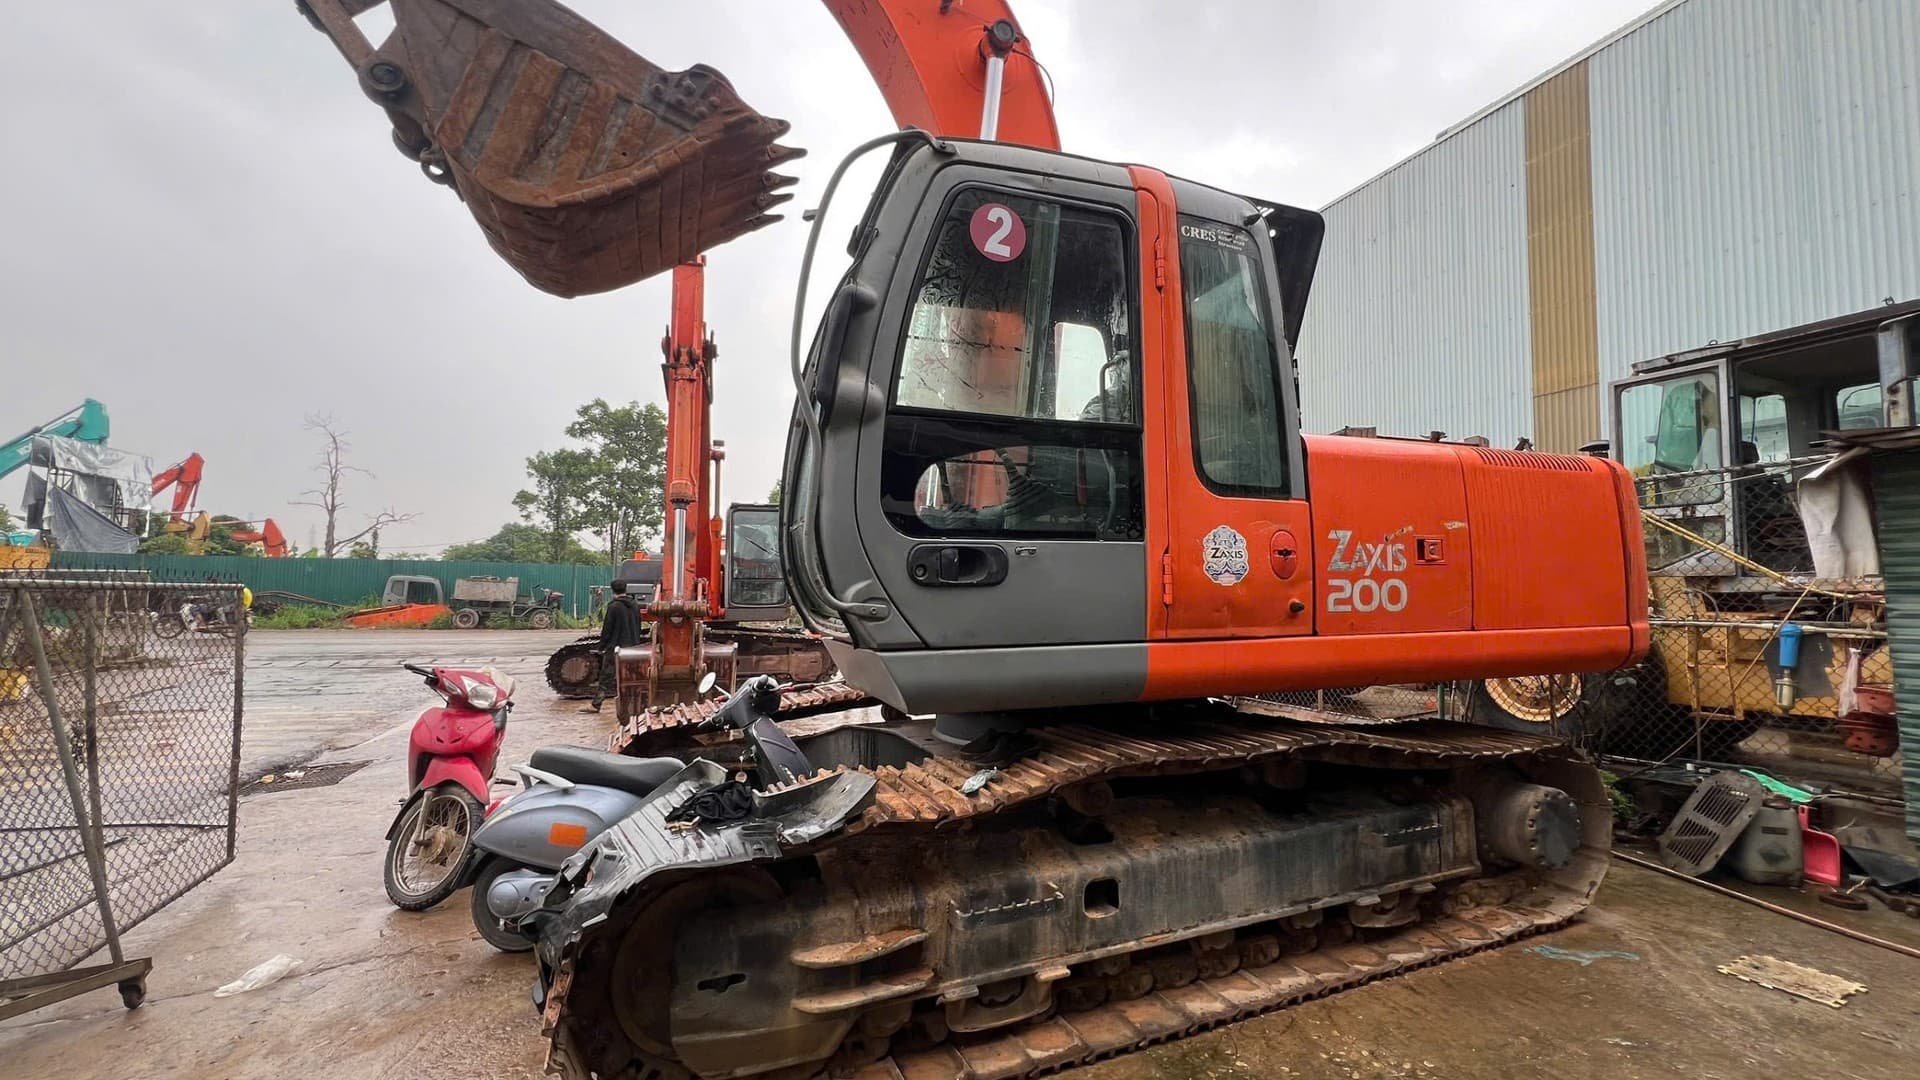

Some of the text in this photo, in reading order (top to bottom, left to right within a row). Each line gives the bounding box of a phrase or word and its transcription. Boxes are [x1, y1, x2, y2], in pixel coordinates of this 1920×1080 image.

[984, 208, 1013, 258] 2
[1181, 225, 1216, 242] CRES
[1211, 547, 1244, 559] ZAXIS
[1327, 529, 1407, 576] ZAXIS
[1327, 578, 1408, 612] 200
